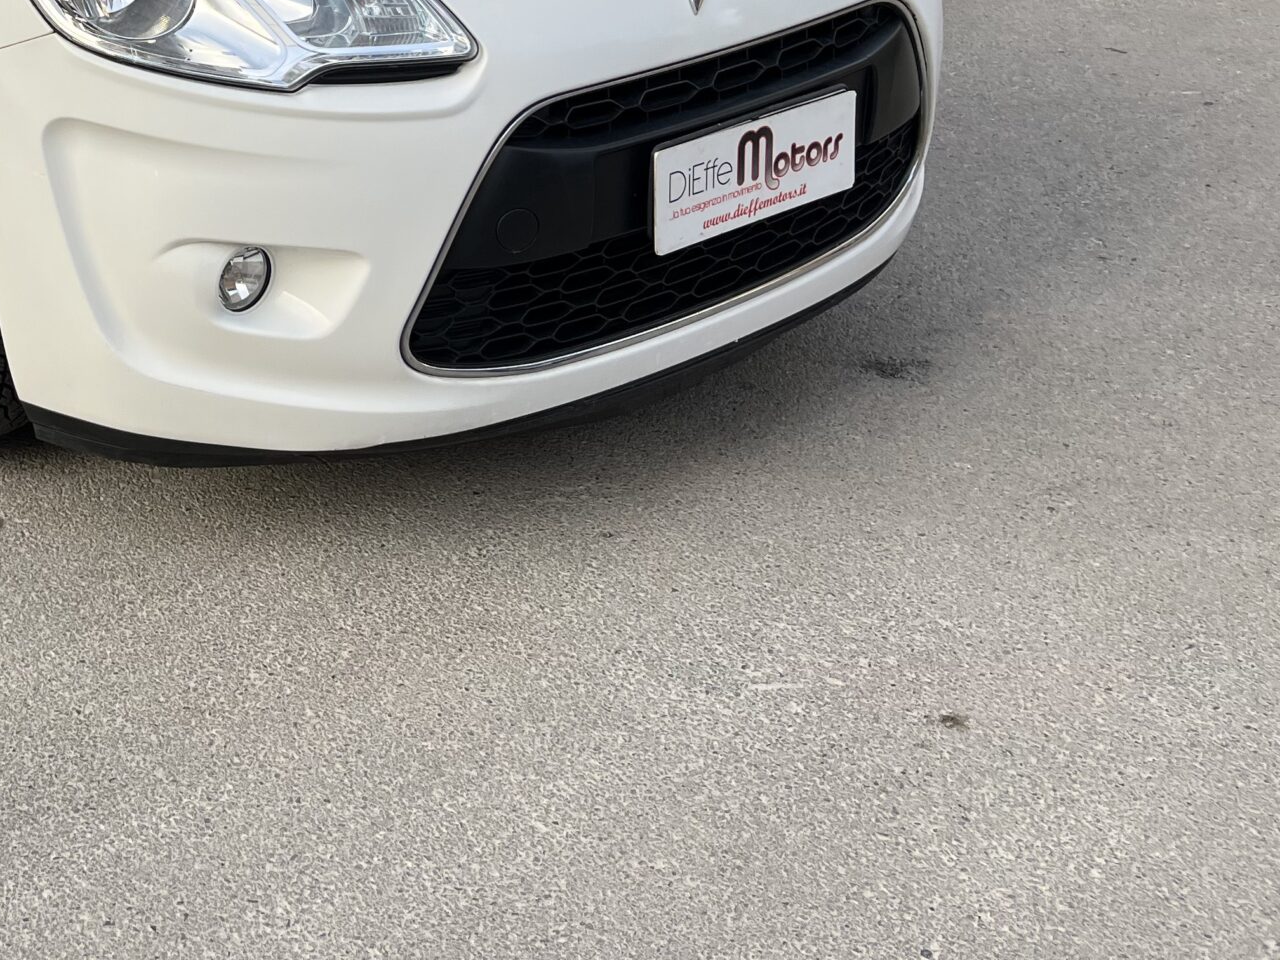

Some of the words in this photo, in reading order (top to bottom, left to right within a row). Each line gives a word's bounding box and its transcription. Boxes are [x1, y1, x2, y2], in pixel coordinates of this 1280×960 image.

[668, 157, 733, 204] DiEffe
[736, 125, 844, 191] Motors
[702, 183, 808, 230] www.dieffemotors.it
